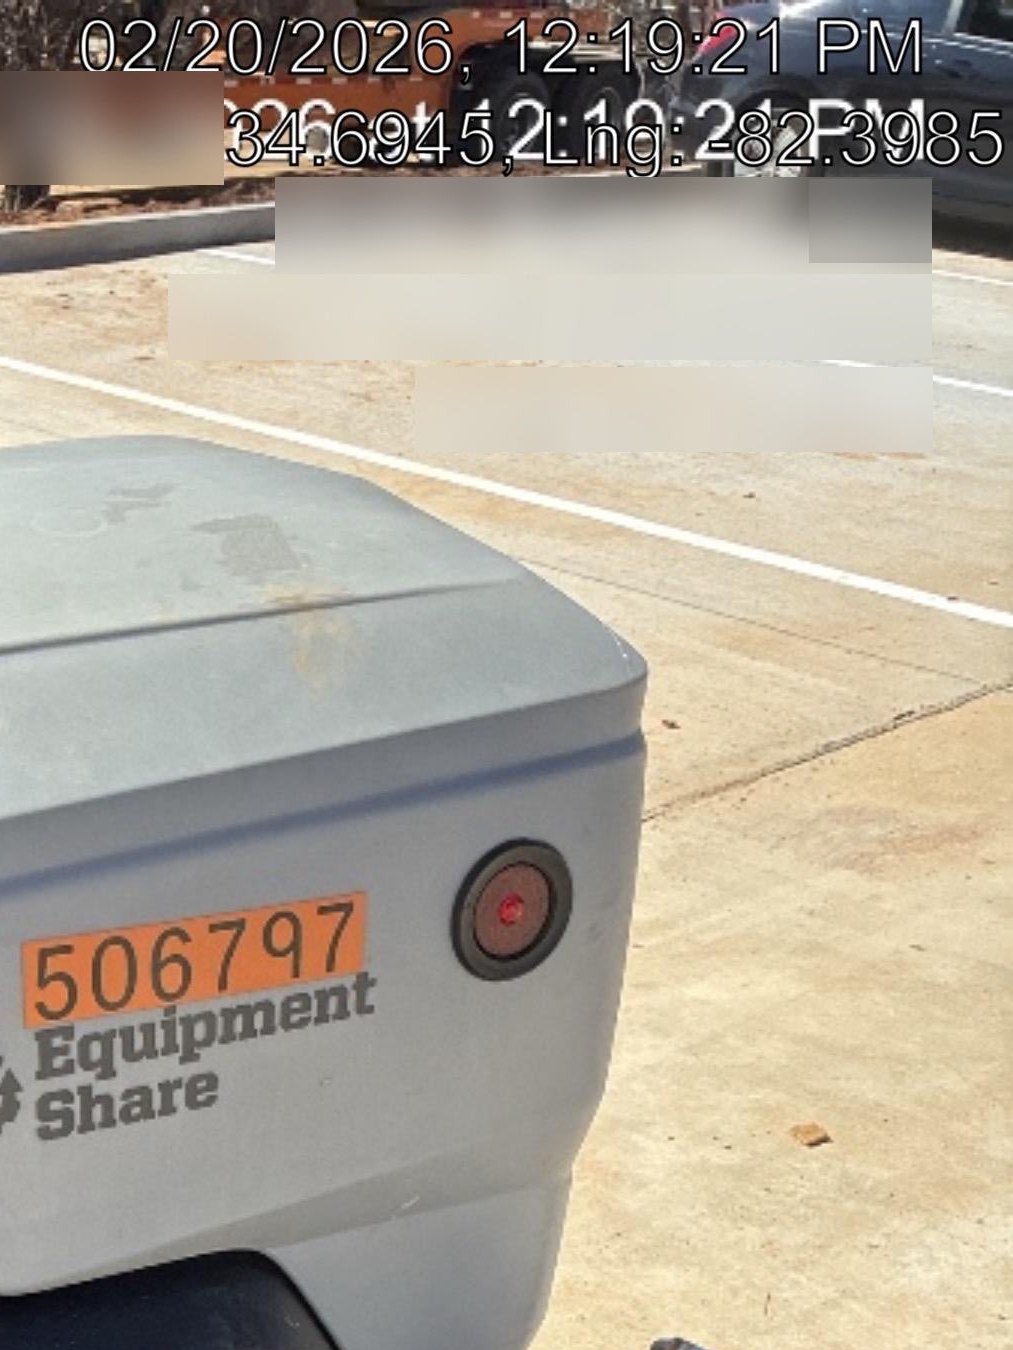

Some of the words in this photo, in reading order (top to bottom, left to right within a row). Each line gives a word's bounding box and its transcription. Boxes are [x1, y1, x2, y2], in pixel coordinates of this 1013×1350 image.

[34, 900, 355, 1022] 506797
[34, 971, 377, 1081] Equipment
[35, 1071, 219, 1142] Share
